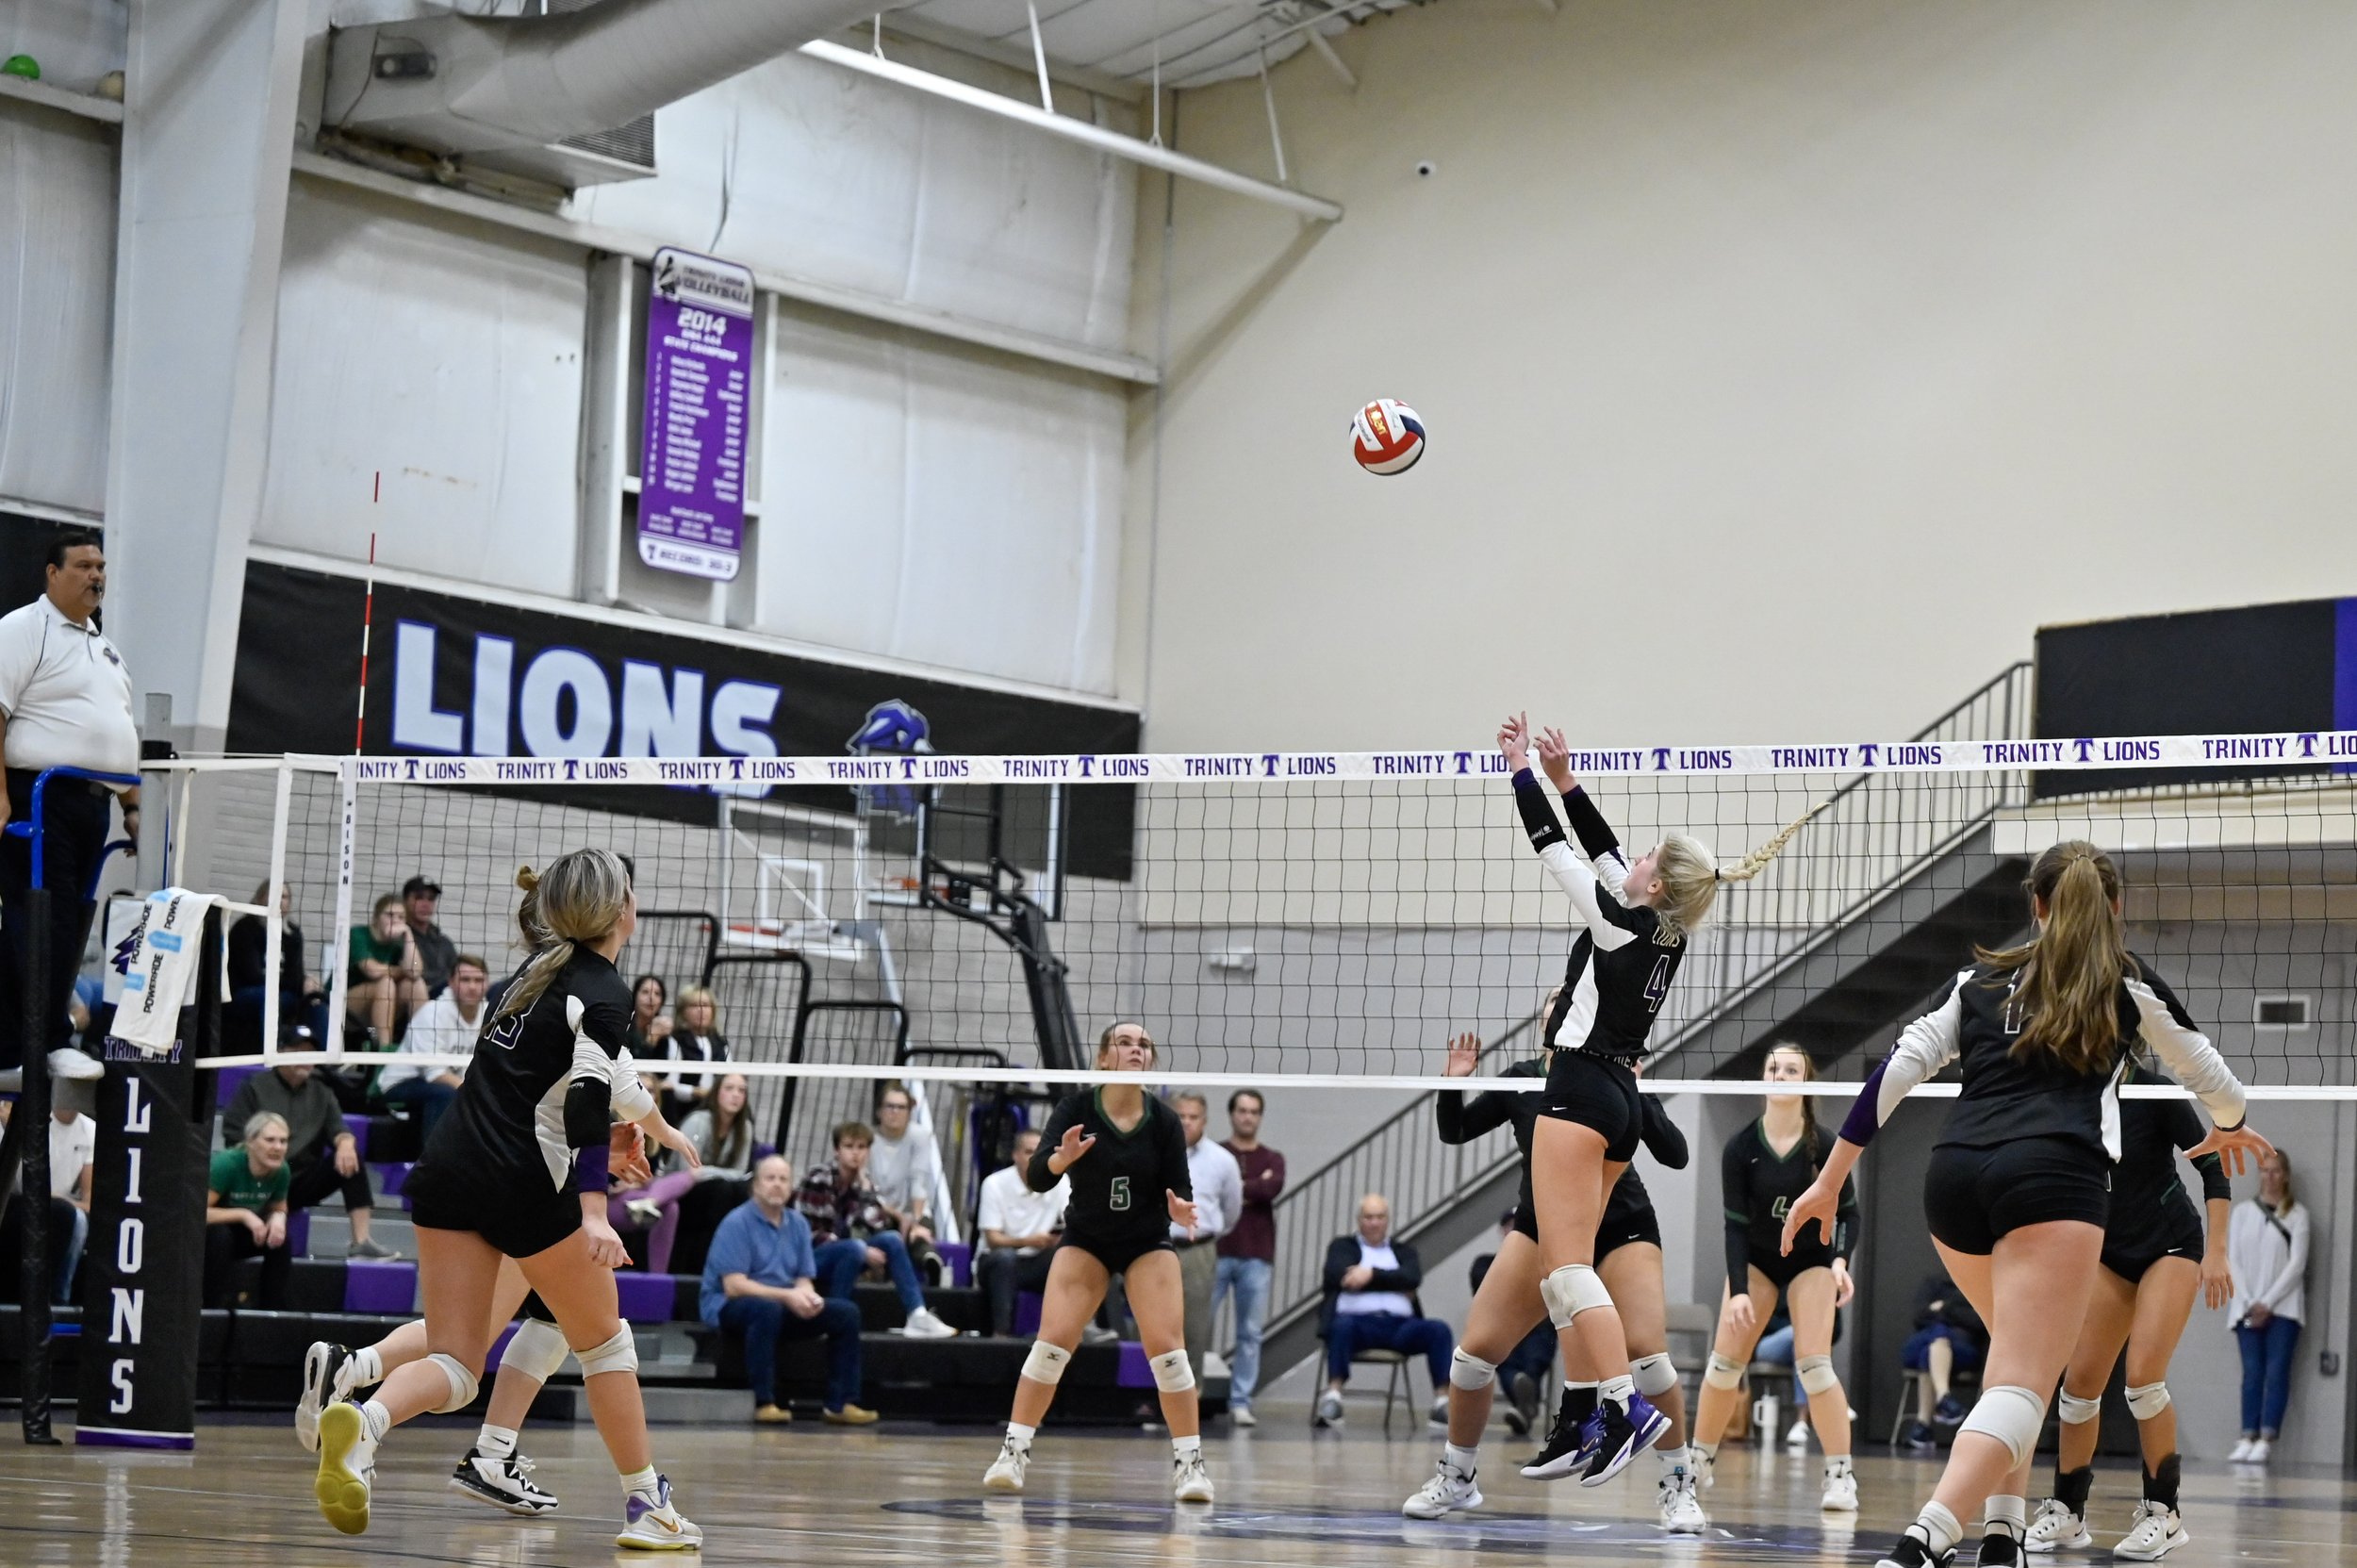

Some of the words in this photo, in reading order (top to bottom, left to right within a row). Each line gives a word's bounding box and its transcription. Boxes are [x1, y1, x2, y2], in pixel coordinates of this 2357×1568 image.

[678, 307, 727, 335] 2014
[391, 619, 782, 799] LIONS
[1771, 747, 1849, 768] TRINITY
[1887, 746, 1942, 766] LIONS
[1982, 742, 2064, 764] TRINITY
[2103, 740, 2160, 761] LIONS
[2201, 737, 2287, 759] TRINITY
[340, 761, 398, 779] INITY
[425, 762, 466, 780] LIONS
[497, 762, 556, 780] TRINITY
[585, 762, 628, 779] LIONS
[659, 762, 722, 780] TRINITY
[752, 762, 796, 779] LIONS
[827, 761, 892, 779] TRINITY
[924, 760, 968, 778] LIONS
[1002, 759, 1069, 778] TRINITY
[1102, 758, 1149, 777] LIONS
[1184, 757, 1253, 777] TRINITY
[1287, 756, 1336, 775] LIONS
[1372, 755, 1444, 774] TRINITY
[1480, 753, 1528, 773] LIO
[1569, 751, 1642, 771] TRINITY
[1679, 750, 1732, 770] LIONS
[342, 814, 352, 885] BISON
[164, 895, 182, 930] POWE
[143, 953, 164, 1015] POWERADE
[1643, 954, 1670, 1013] 4
[1110, 1176, 1131, 1212] 5
[108, 1077, 151, 1414] LIONS
